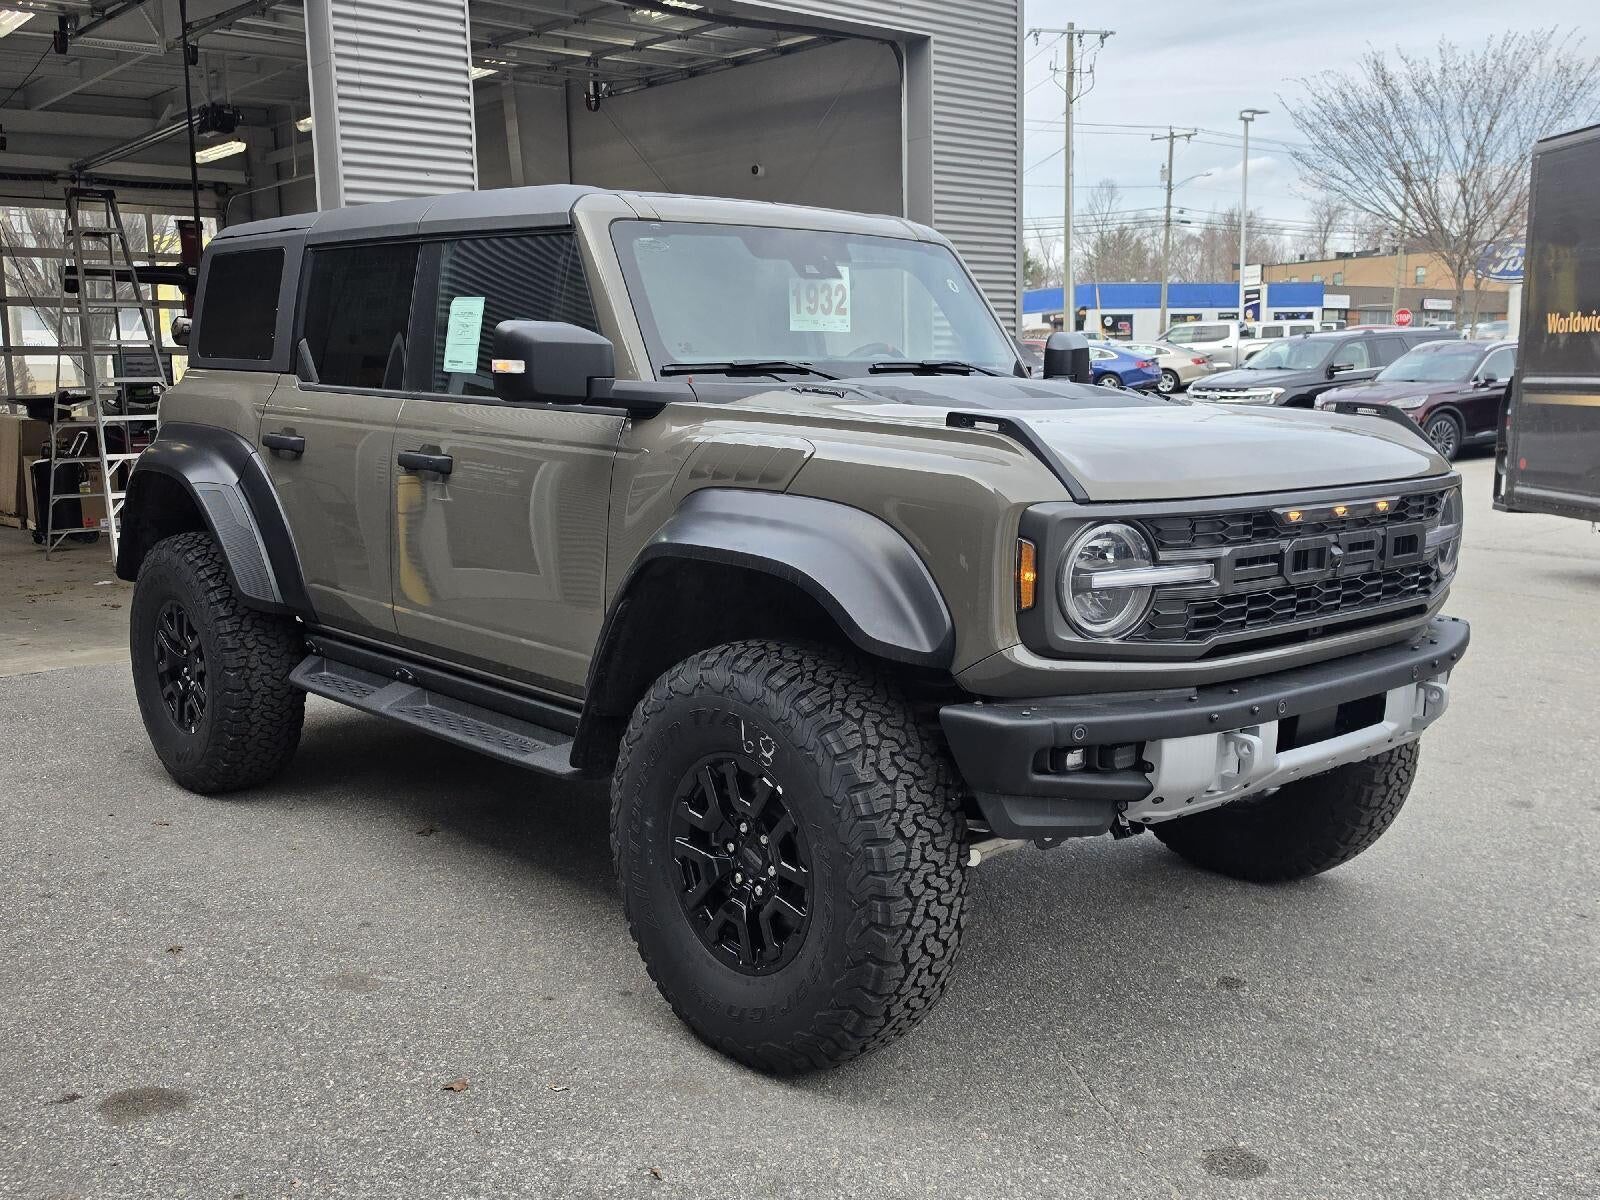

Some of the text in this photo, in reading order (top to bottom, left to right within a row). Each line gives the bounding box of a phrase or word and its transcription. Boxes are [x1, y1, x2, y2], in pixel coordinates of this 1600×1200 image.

[791, 282, 848, 317] 1932
[1395, 313, 1411, 323] STOP
[1221, 522, 1427, 596] FORD
